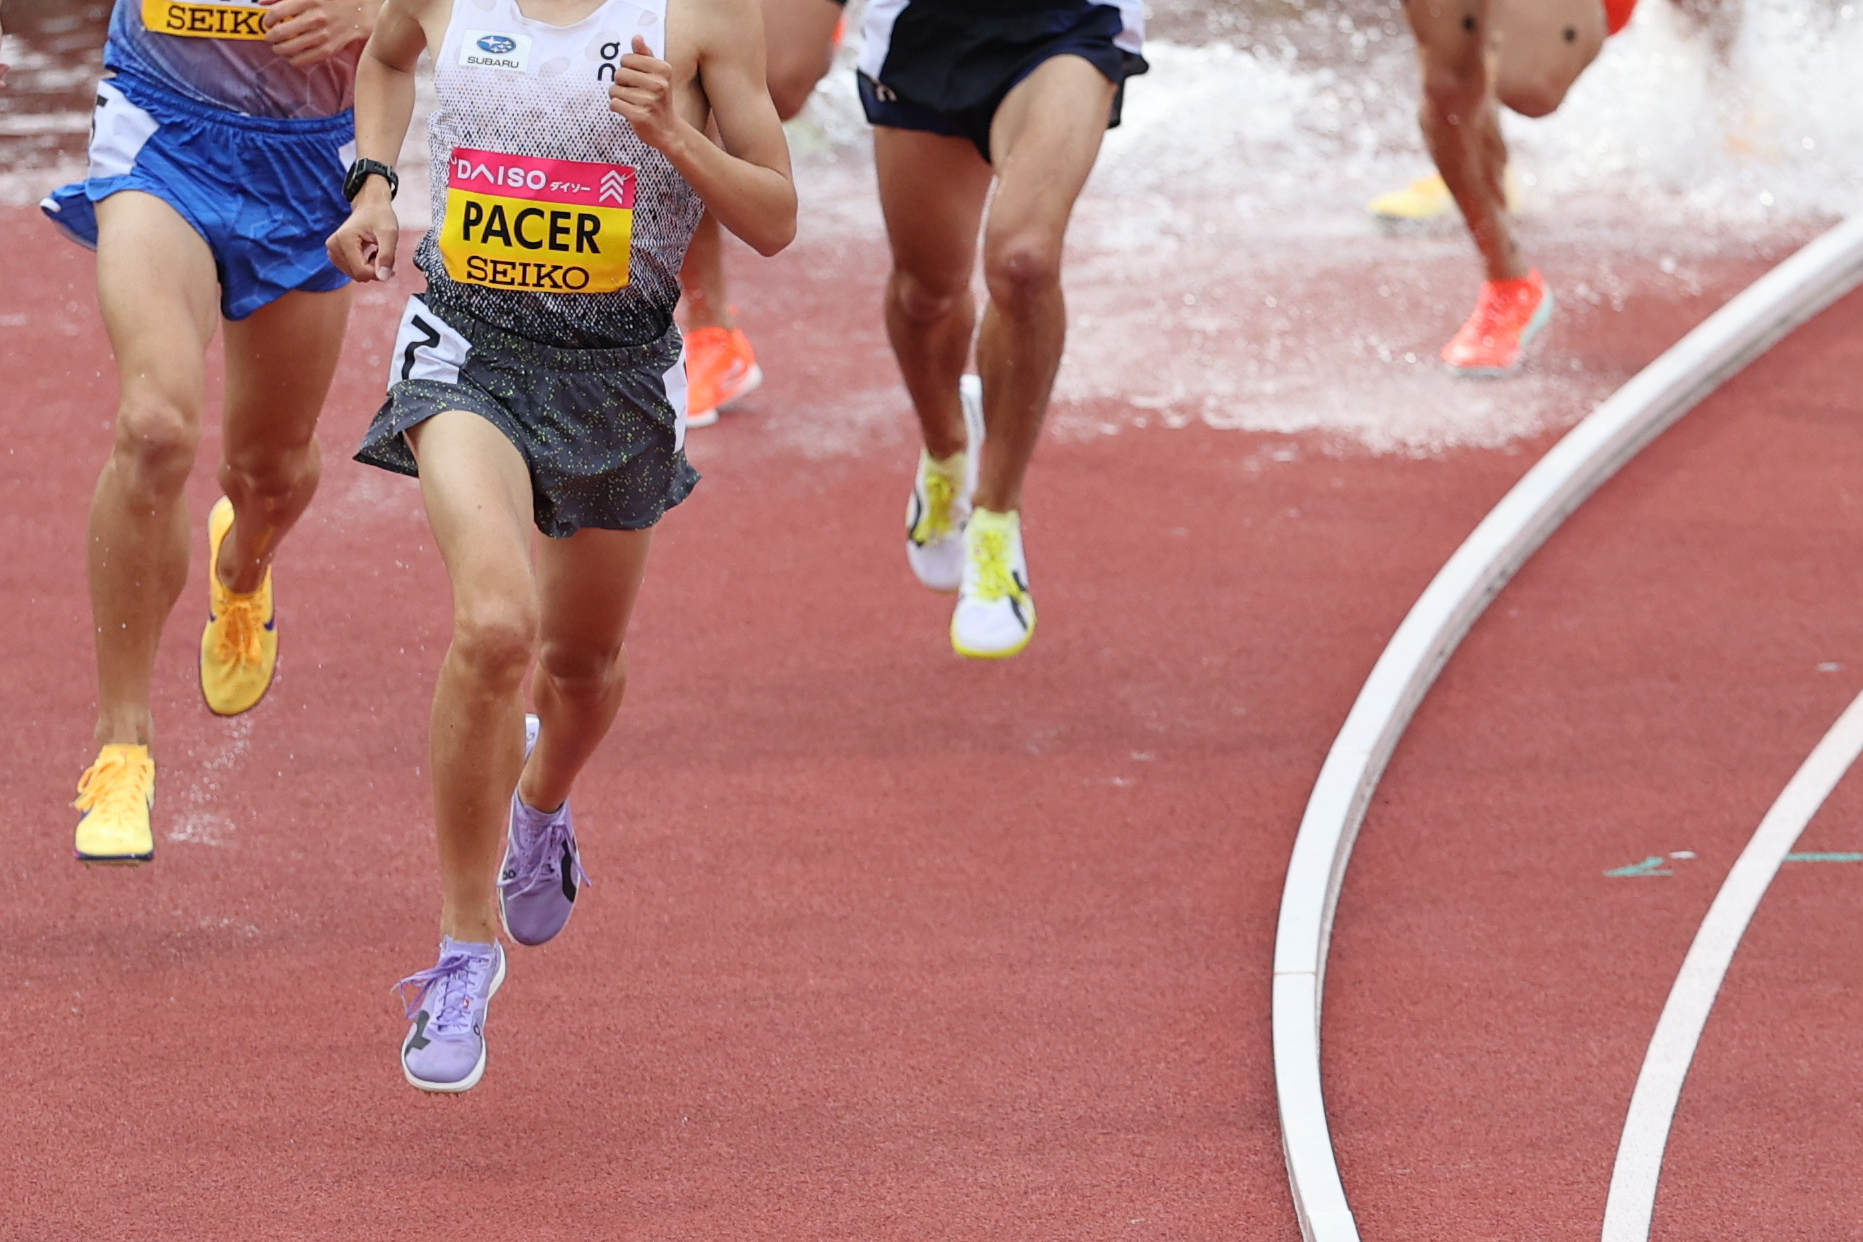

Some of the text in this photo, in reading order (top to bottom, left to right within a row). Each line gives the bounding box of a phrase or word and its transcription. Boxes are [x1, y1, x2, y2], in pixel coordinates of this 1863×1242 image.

[467, 56, 520, 69] SUBARU
[457, 159, 591, 193] DAISO ダイソー
[463, 200, 602, 254] PACER
[466, 255, 590, 290] SEIKO
